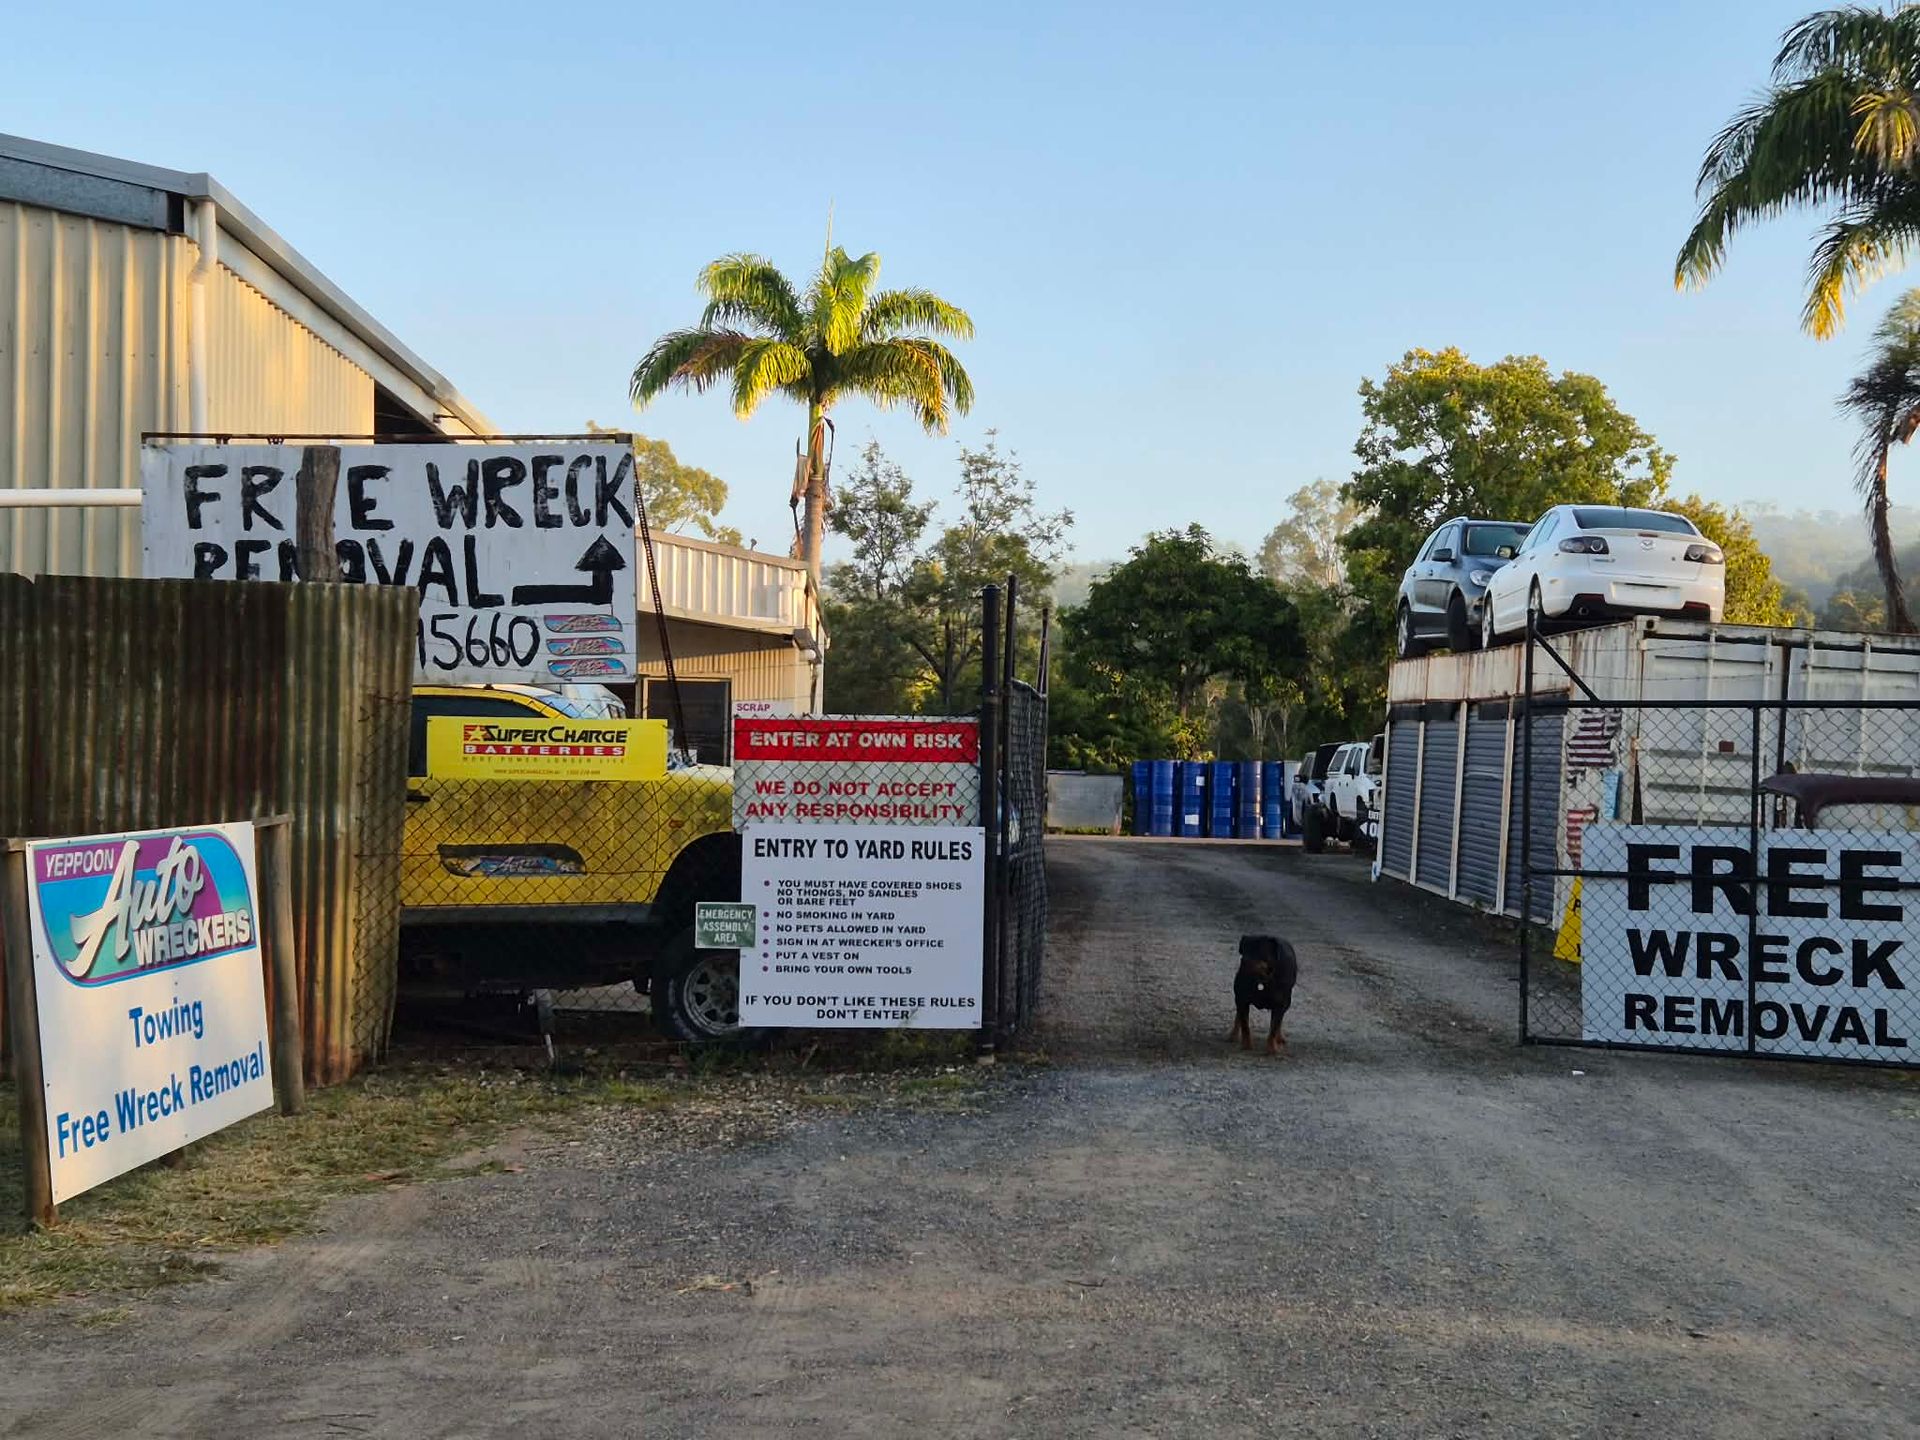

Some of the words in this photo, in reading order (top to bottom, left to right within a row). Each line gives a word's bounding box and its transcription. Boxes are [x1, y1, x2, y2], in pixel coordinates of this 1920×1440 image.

[183, 464, 394, 531] FRE
[426, 453, 635, 530] WRECK
[736, 703, 770, 712] SCRAP
[750, 732, 819, 748] ENTER
[825, 732, 852, 748] AT
[858, 733, 906, 748] OWN
[913, 734, 963, 749] RISK
[465, 745, 624, 755] BATTERIES
[755, 781, 786, 795] WE
[793, 782, 821, 796] DO
[828, 782, 871, 796] NOT
[877, 783, 957, 797] ACCEPT
[746, 803, 788, 817] ANY
[796, 803, 966, 819] RESPONSIBILITY
[754, 838, 818, 858] ENTRY
[824, 840, 849, 858] TO
[855, 840, 905, 860] YARD
[911, 841, 972, 861] RULES
[45, 848, 114, 878] YEPPOON
[778, 880, 801, 888] YOU
[804, 880, 835, 889] MUST
[838, 880, 868, 889] HAVE
[872, 881, 922, 890] COVERED
[925, 882, 962, 890] SHOES
[1627, 843, 1903, 922] FREE
[797, 889, 846, 898] THONGS,
[849, 890, 864, 898] NO
[868, 890, 918, 898] SANDLES
[65, 836, 204, 978] Auto
[778, 898, 793, 906] OR
[796, 898, 826, 906] BARE
[830, 898, 856, 906] FEET
[699, 909, 753, 920] EMERGENCY
[776, 910, 793, 919] NO
[796, 911, 848, 920] SMOKING
[852, 912, 863, 920] IN
[866, 912, 895, 920] YARD
[703, 922, 750, 932] ASSEMBLY
[776, 924, 793, 932] NO
[796, 924, 824, 933] PETS
[826, 924, 878, 934] ALLOWED
[882, 925, 894, 934] IN
[897, 926, 926, 934] YARD
[132, 909, 251, 965] WRECKERS
[714, 933, 737, 943] AREA
[776, 938, 803, 946] SIGN
[807, 938, 818, 946] IN
[821, 938, 835, 947] AT
[838, 938, 902, 948] WRECKER'S
[905, 939, 944, 948] OFFICE
[776, 952, 798, 960] PUT
[801, 952, 809, 960] A
[812, 952, 840, 960] VEST
[843, 952, 860, 960] ON
[1626, 928, 1906, 990] WRECK
[776, 965, 810, 974] BRING
[814, 966, 844, 974] YOUR
[847, 966, 872, 974] OWN
[876, 966, 912, 975] TOOLS
[746, 996, 758, 1005] IF
[763, 996, 793, 1006] YOU
[796, 996, 840, 1006] DON'T
[844, 996, 875, 1006] LIKE
[879, 997, 926, 1007] THESE
[930, 998, 976, 1008] RULES
[816, 1009, 858, 1020] DON'T
[864, 1010, 910, 1020] ENTER
[129, 996, 204, 1048] Towing
[1624, 993, 1907, 1048] REMOVAL
[56, 1109, 110, 1159] Free
[114, 1074, 186, 1133] Wreck
[190, 1041, 265, 1104] Removal
